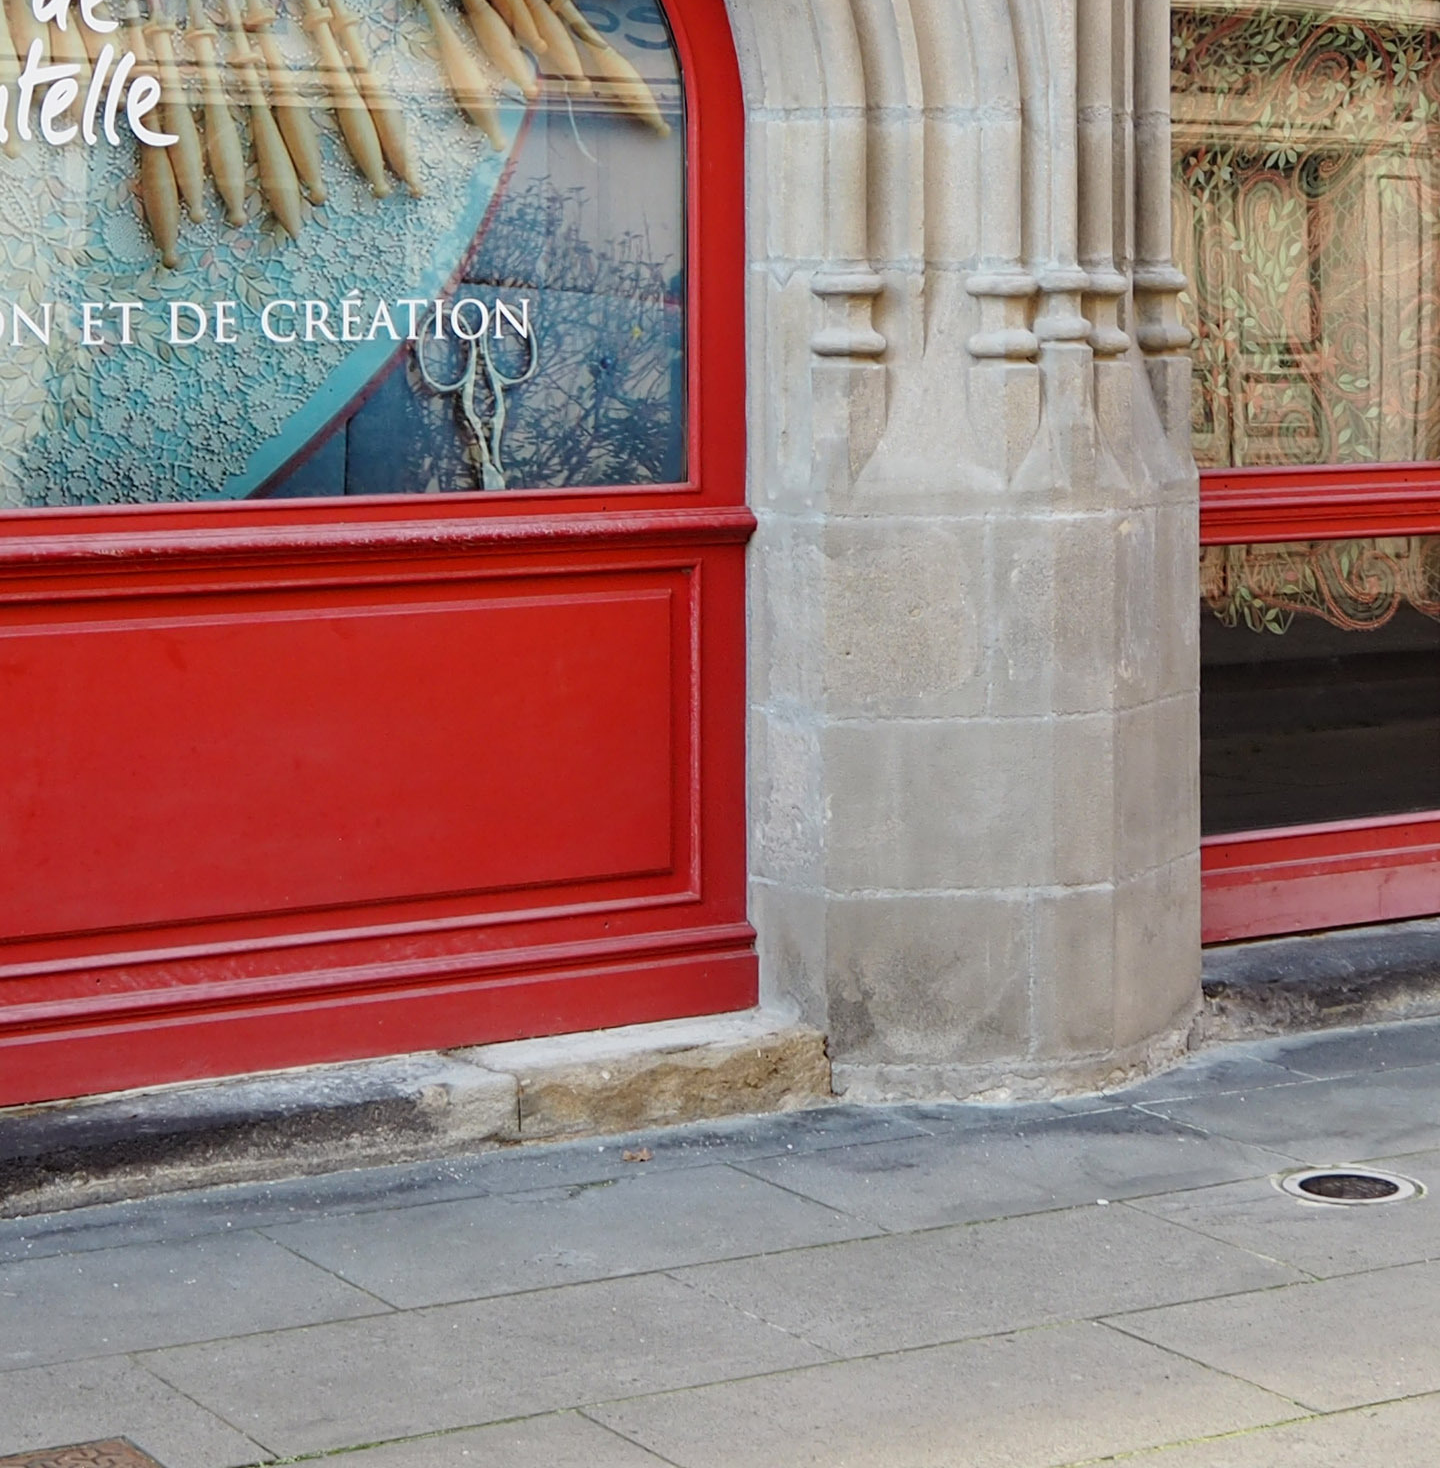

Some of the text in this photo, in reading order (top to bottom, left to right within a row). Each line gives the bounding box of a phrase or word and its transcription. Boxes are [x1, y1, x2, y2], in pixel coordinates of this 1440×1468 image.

[81, 301, 144, 346] ET
[169, 301, 238, 344] DE
[260, 288, 531, 342] CRÉATION
